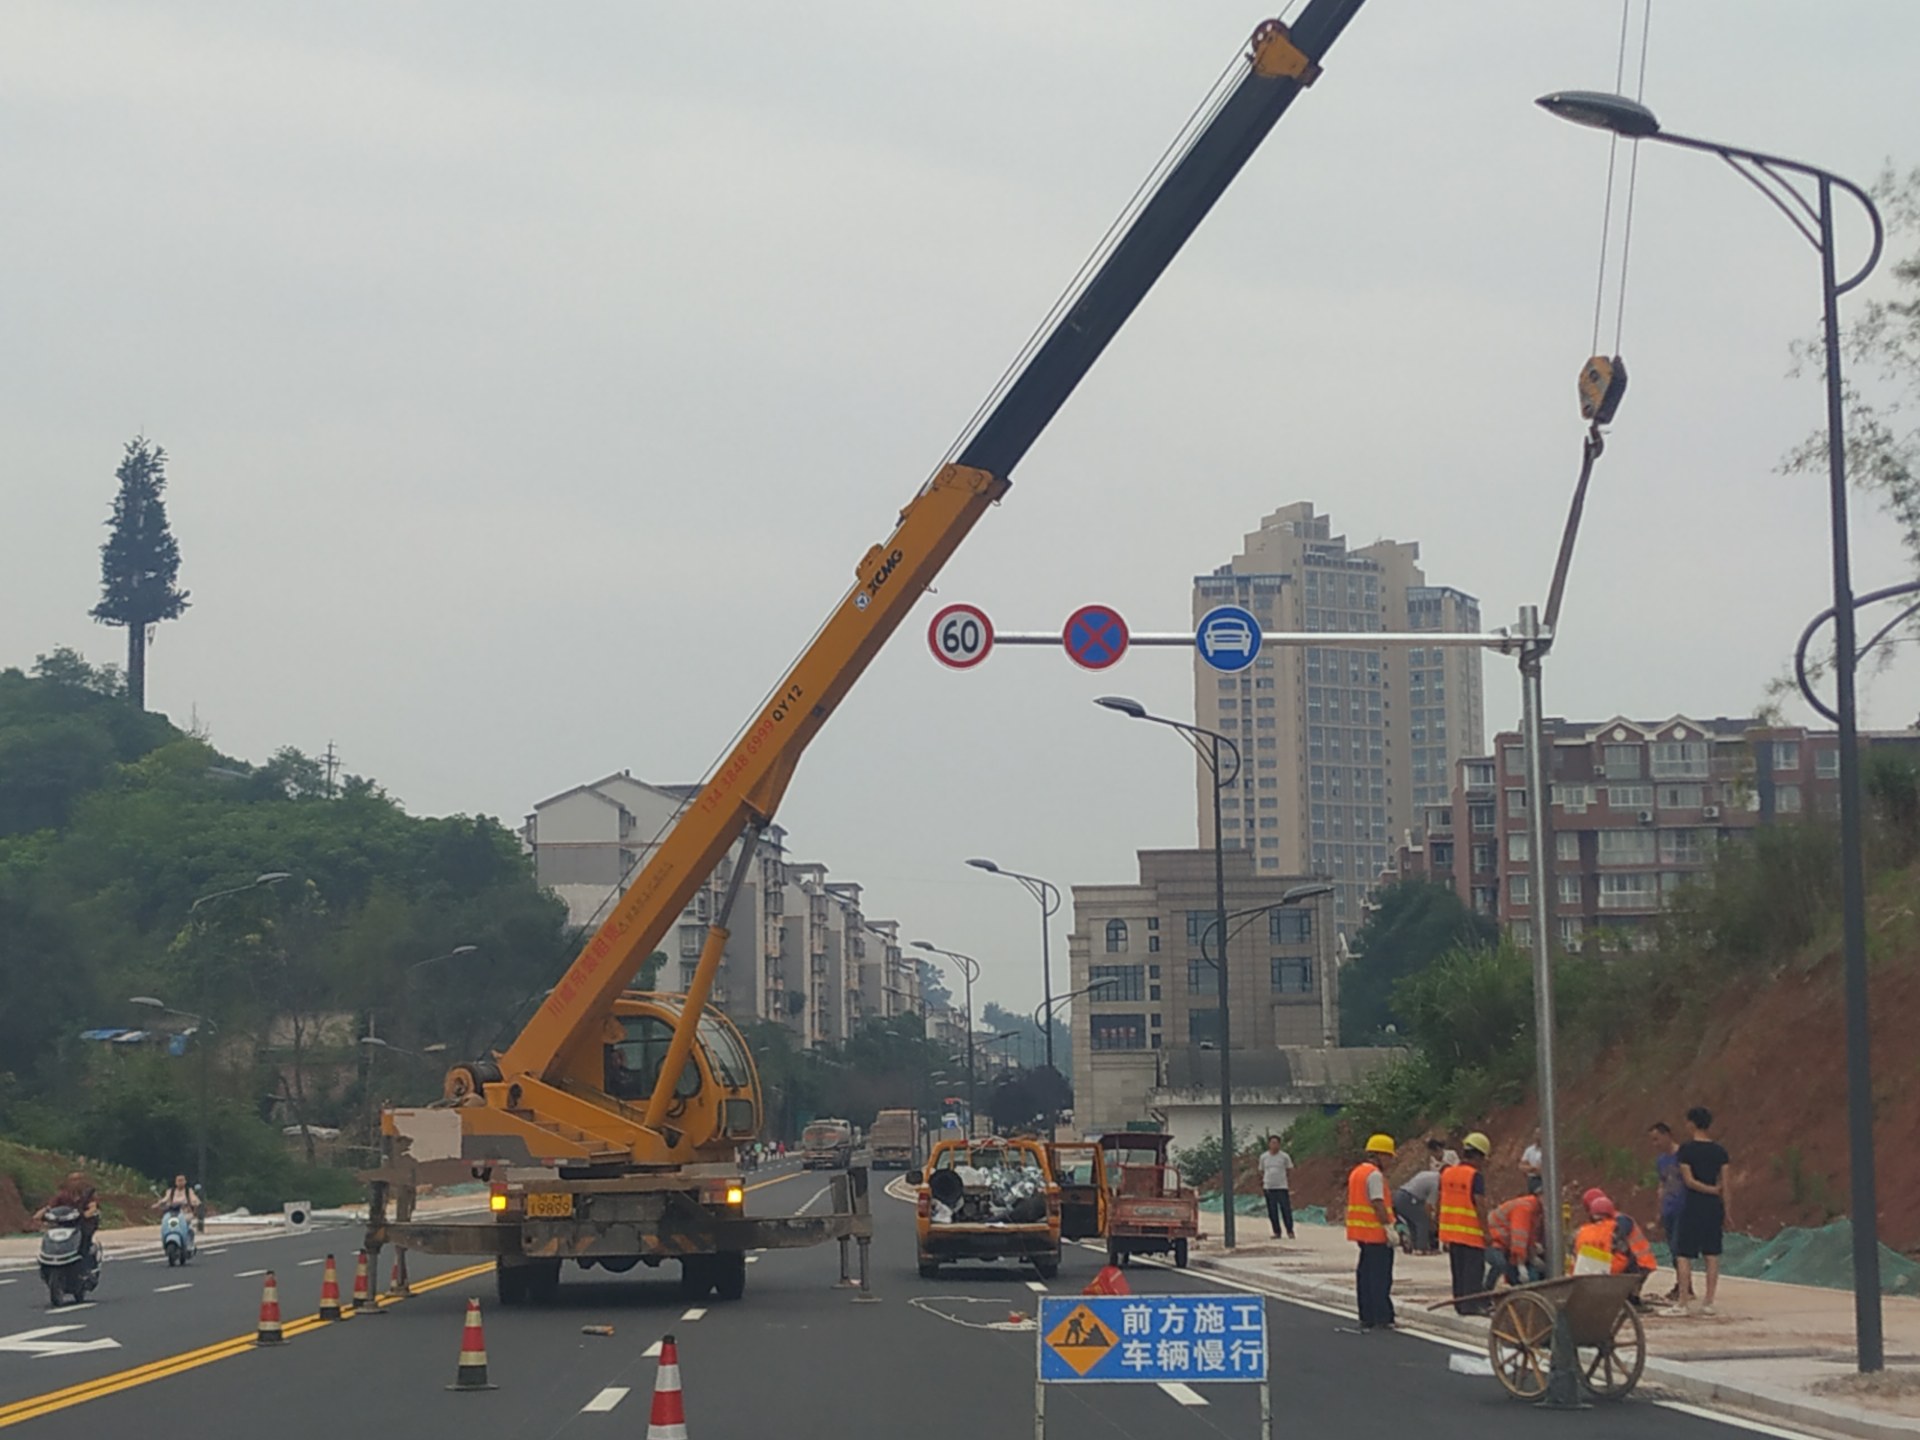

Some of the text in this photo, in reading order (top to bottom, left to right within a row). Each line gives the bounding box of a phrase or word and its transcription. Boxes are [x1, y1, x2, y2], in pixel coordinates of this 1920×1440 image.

[866, 548, 904, 596] XCMG
[943, 619, 979, 653] 60
[771, 684, 803, 723] QY12
[745, 719, 775, 755] 6999
[1121, 1303, 1262, 1334] 前方施工
[1121, 1339, 1262, 1372] 车辆慢行
